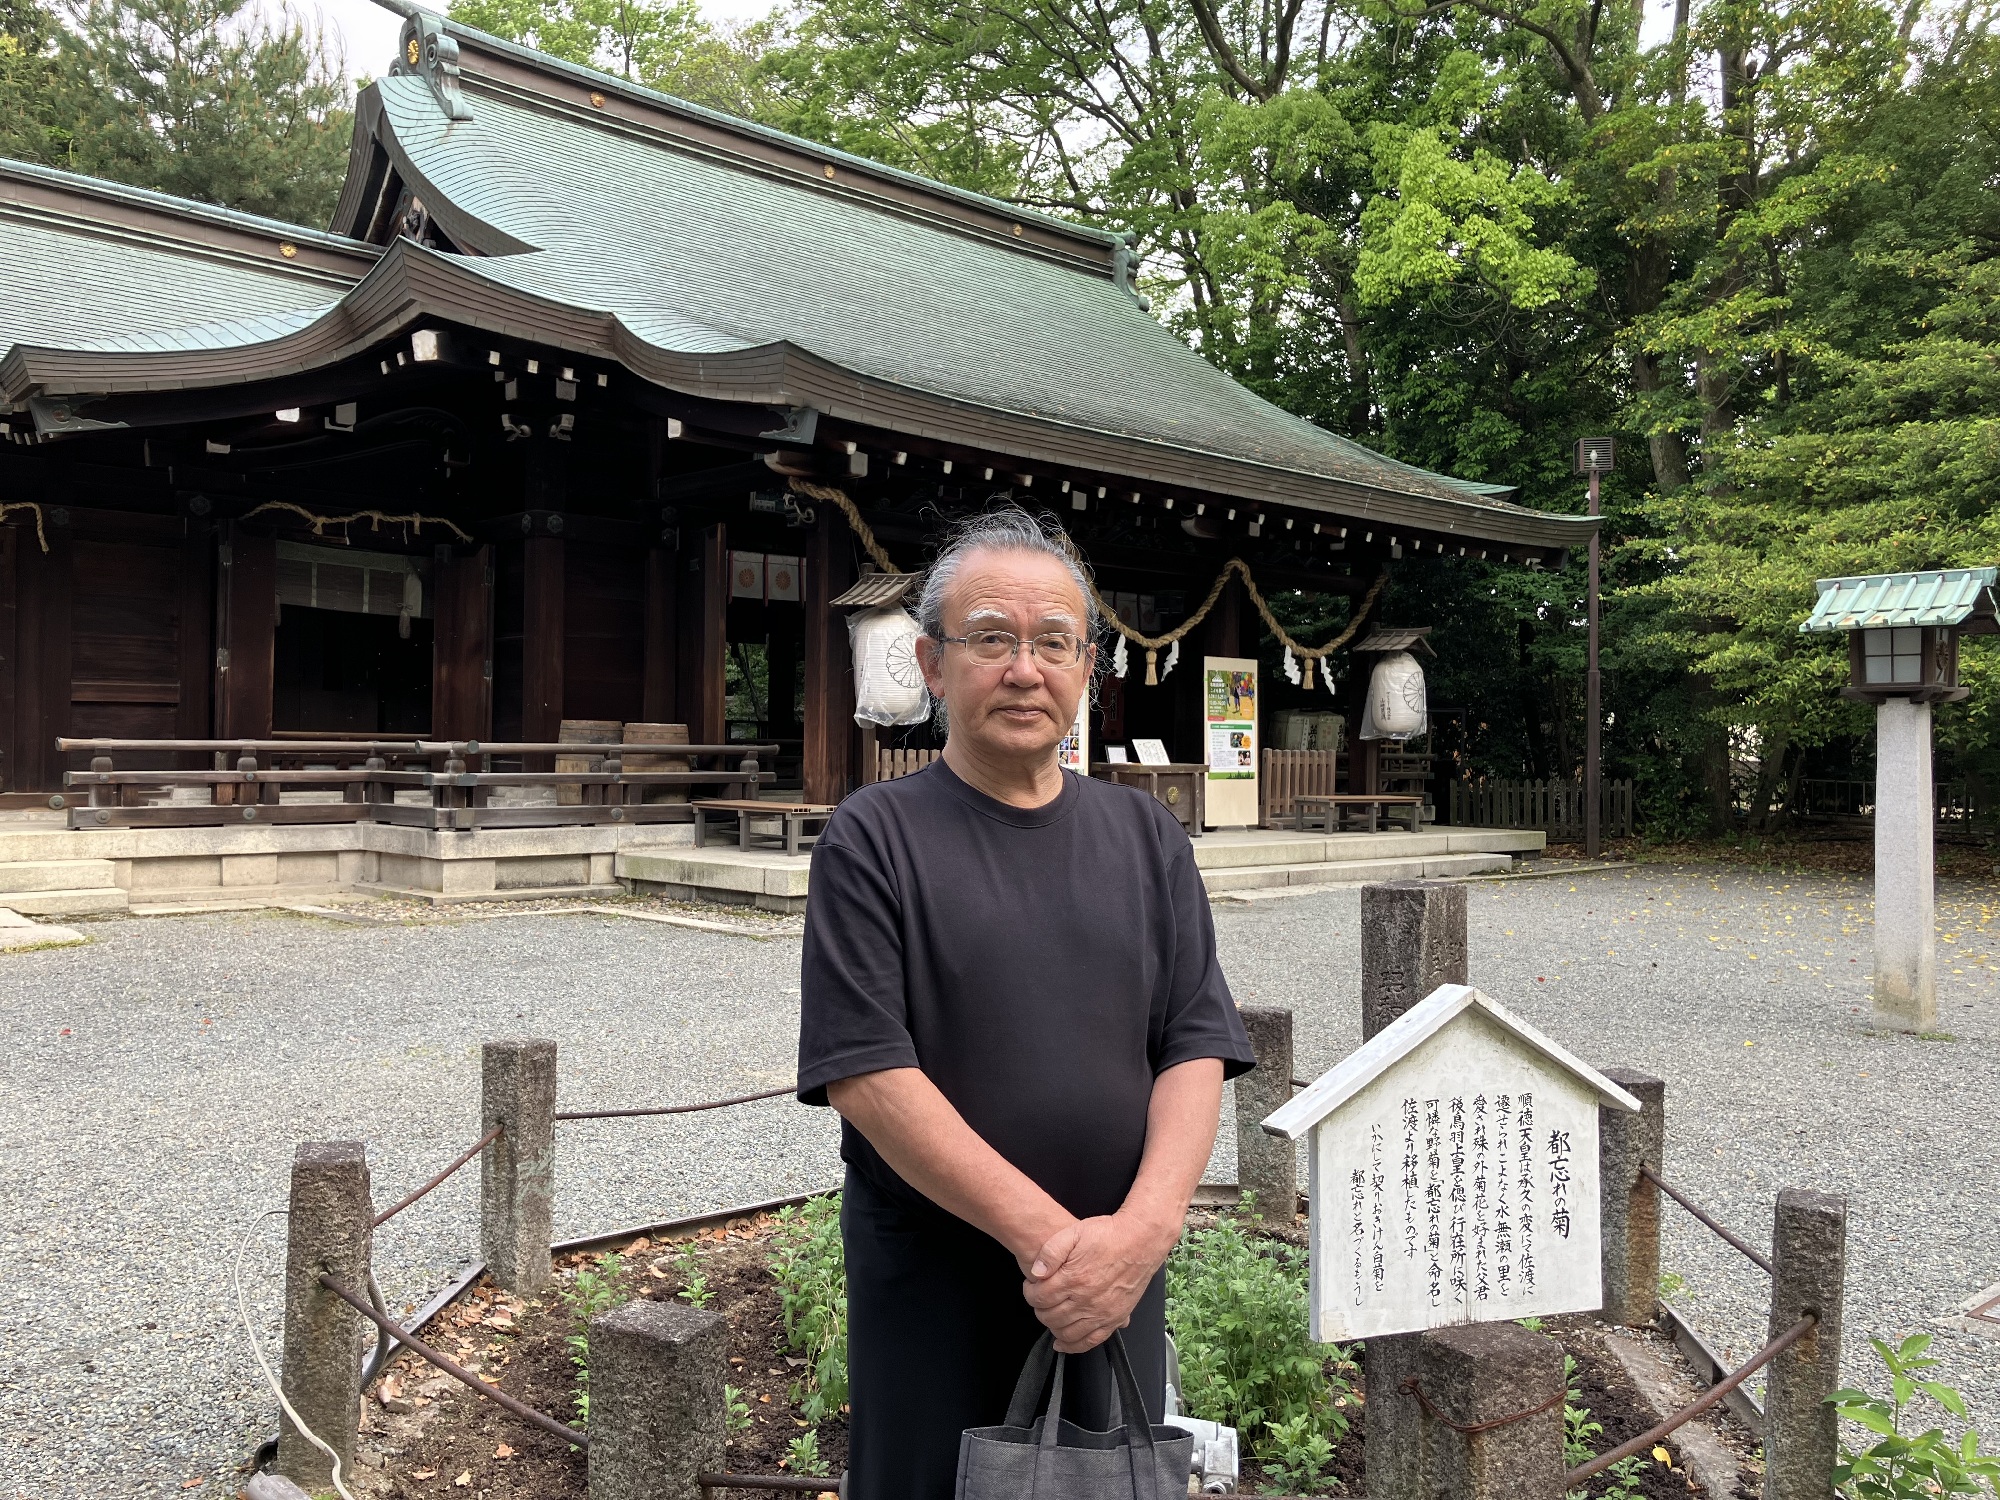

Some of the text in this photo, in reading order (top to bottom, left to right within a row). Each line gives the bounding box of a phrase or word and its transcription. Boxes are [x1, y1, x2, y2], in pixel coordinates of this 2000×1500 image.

[1400, 1097, 1420, 1259] 佐渡より移植したものです
[1545, 1129, 1572, 1240] 都忘れの菊
